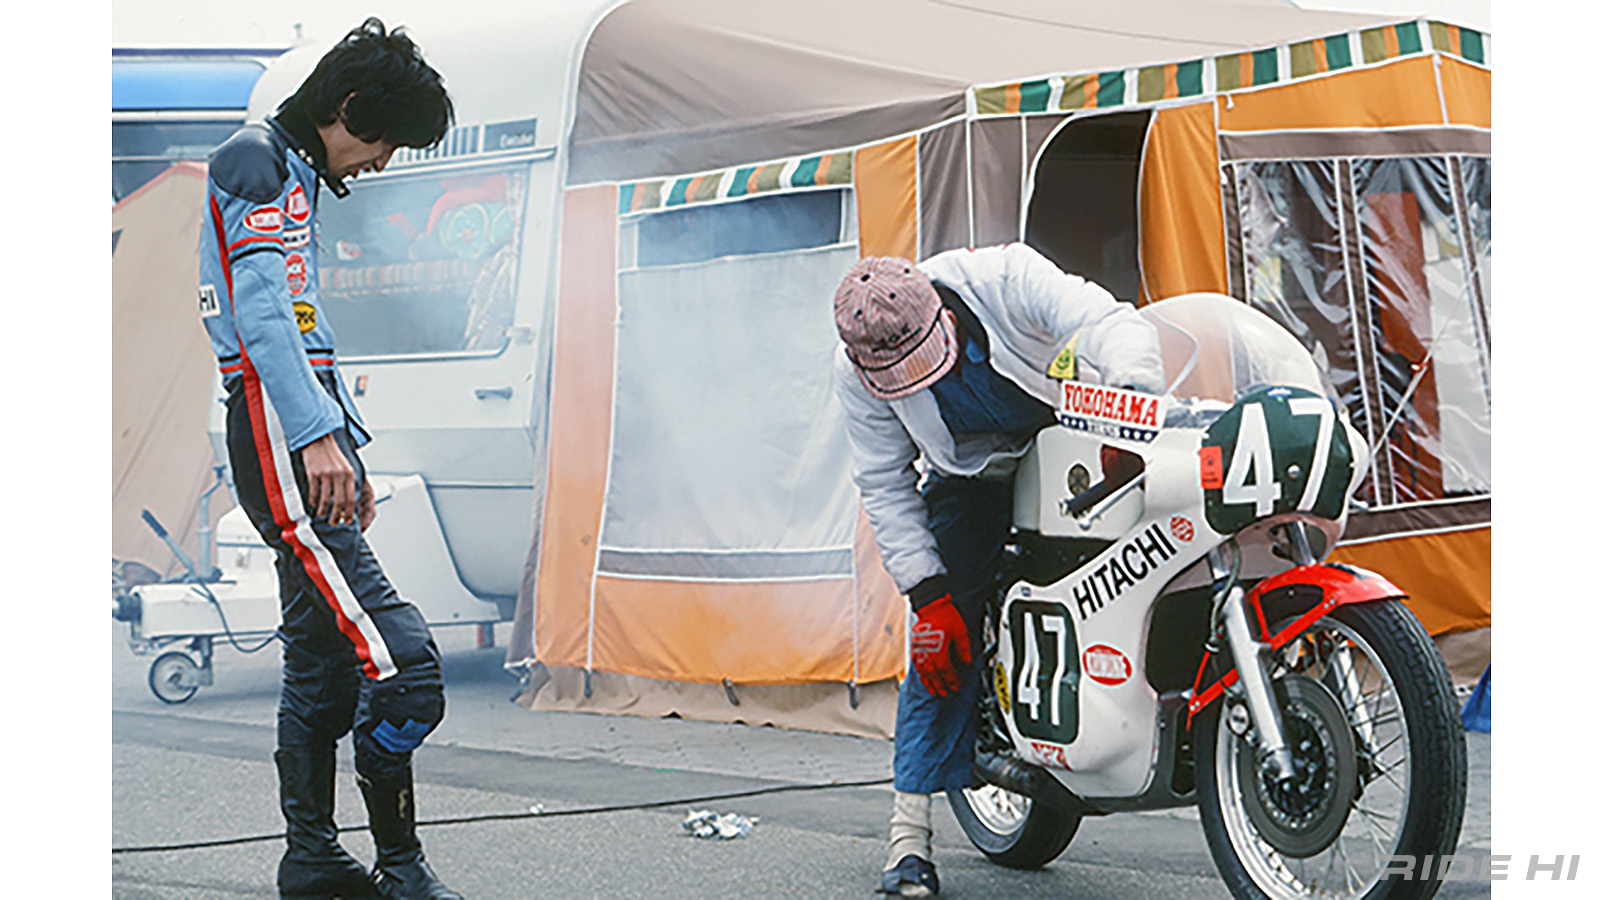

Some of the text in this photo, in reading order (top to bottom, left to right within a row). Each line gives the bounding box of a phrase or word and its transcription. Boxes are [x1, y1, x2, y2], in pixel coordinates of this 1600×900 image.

[1064, 383, 1158, 426] YOKOHAMA
[1223, 398, 1336, 517] 47
[1072, 523, 1178, 620] HITACHI
[1017, 612, 1067, 726] 47
